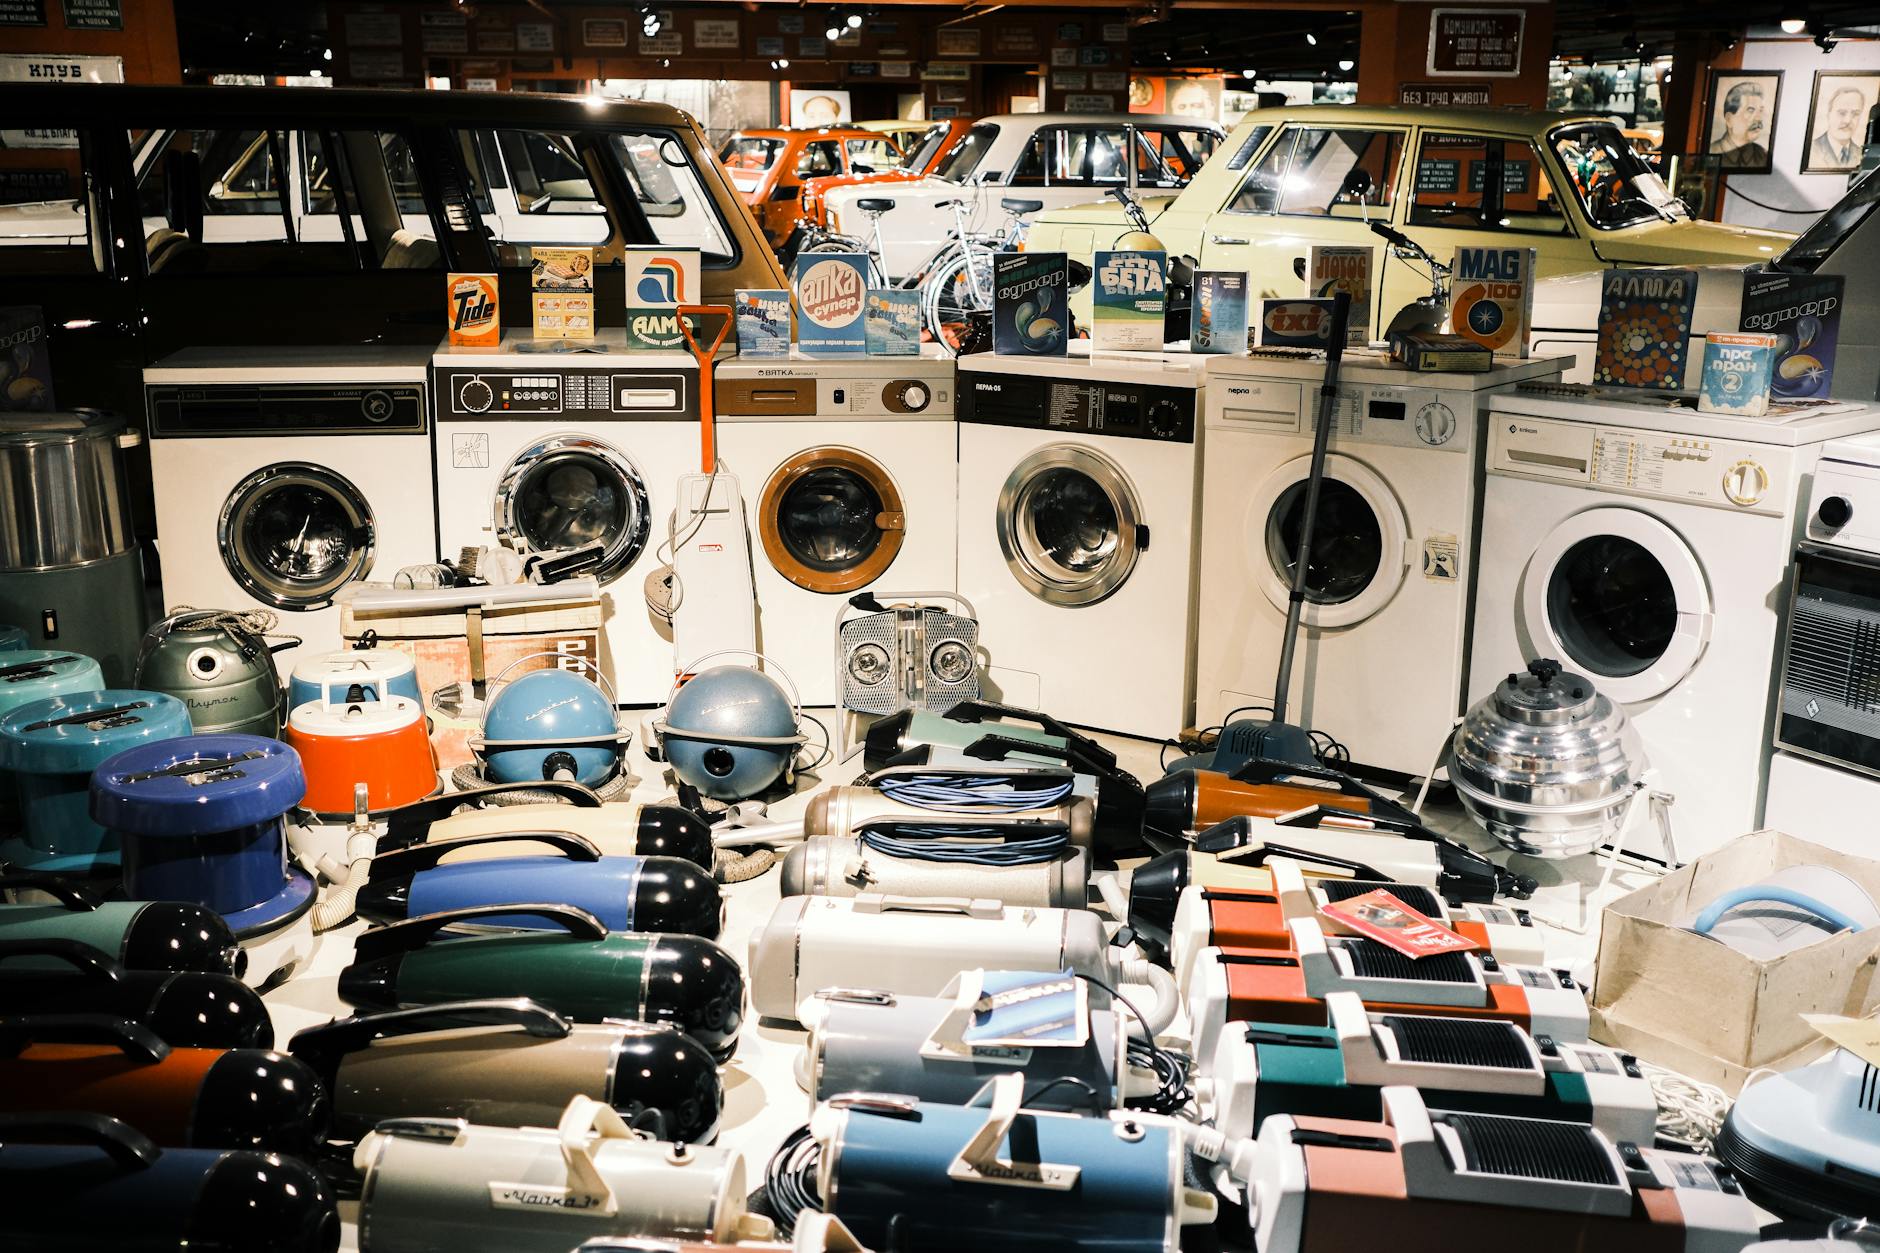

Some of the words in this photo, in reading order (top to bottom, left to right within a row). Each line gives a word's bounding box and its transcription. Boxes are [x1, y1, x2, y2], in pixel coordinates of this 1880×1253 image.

[29, 64, 82, 78] КЛУБ
[1403, 91, 1422, 104] БЕЗ
[1426, 91, 1449, 105] ТРУД
[1452, 91, 1489, 105] ЖИВОТА
[1460, 248, 1520, 279] MAG
[803, 264, 857, 307] алка
[998, 270, 1065, 300] супер
[1100, 267, 1164, 292] БЕТА
[1201, 277, 1213, 286] 81
[1605, 276, 1683, 298] АЛМА
[1488, 284, 1522, 298] 100
[454, 290, 495, 330] Tide
[814, 297, 857, 317] супер
[1744, 297, 1837, 330] супер
[1724, 374, 1739, 390] 2
[187, 695, 239, 709] Плутон
